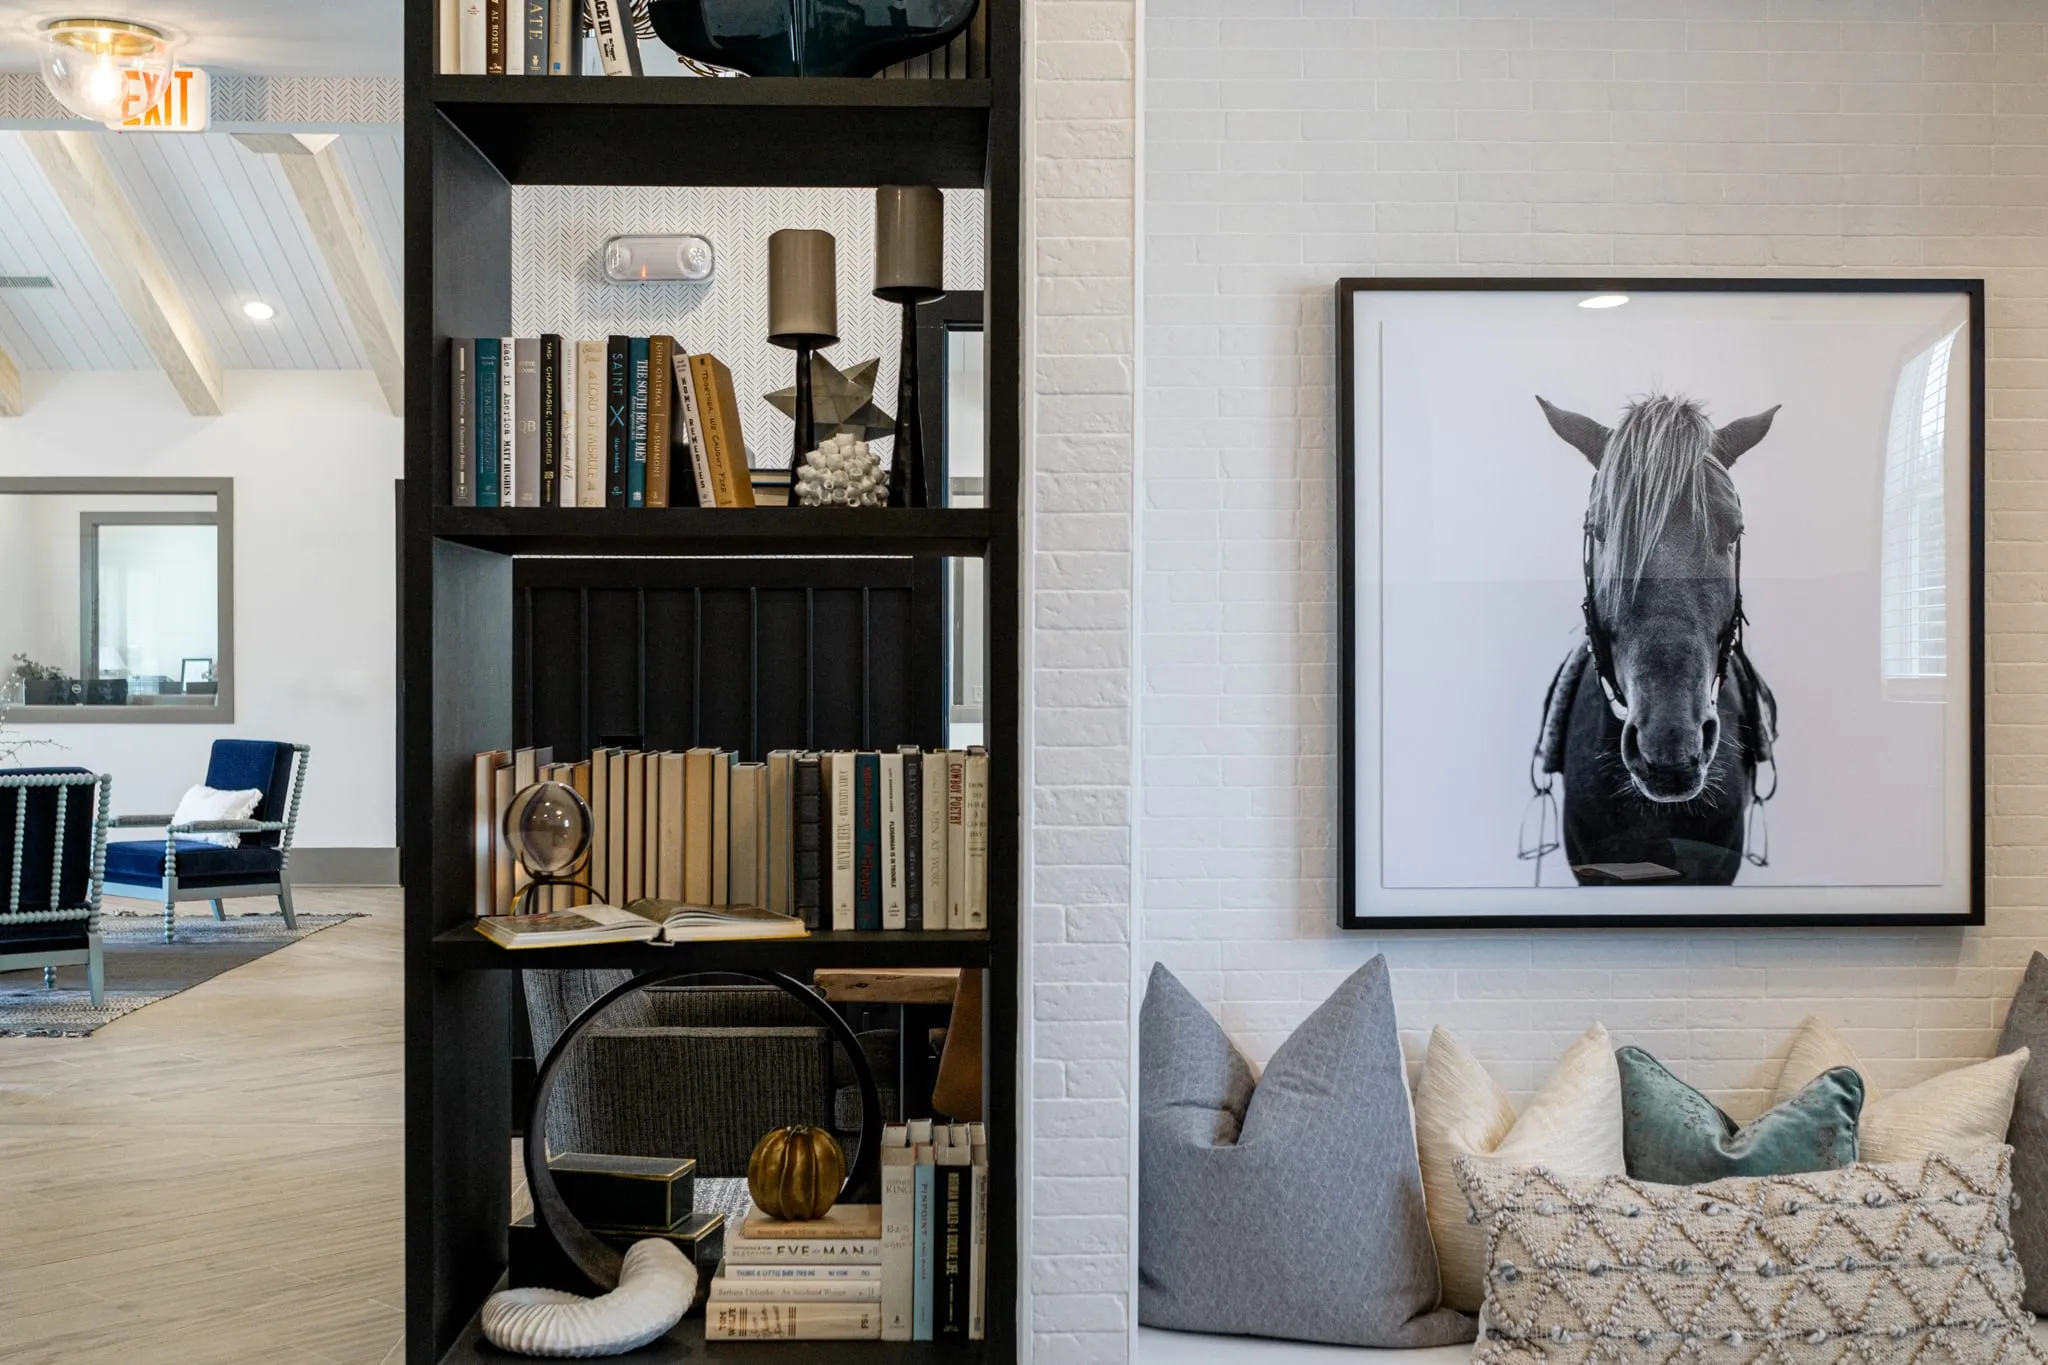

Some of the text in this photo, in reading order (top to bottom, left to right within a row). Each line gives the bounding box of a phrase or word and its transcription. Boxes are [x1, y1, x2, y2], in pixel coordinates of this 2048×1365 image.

[491, 10, 499, 22] AL
[594, 0, 610, 19] CE
[491, 25, 499, 54] ROKER
[598, 20, 612, 35] III
[121, 70, 193, 126] EXIT
[503, 344, 512, 368] Made
[655, 342, 663, 365] JOHN
[503, 375, 512, 387] in
[545, 366, 553, 418] CHAMPAGNE,
[609, 353, 625, 428] SAINT X
[503, 393, 512, 435] America
[634, 360, 648, 464] THE SOUTH BEACH DIET
[588, 382, 600, 479] LORD OF MISRULE
[681, 377, 692, 413] HOME
[688, 419, 706, 489] REMEDIES
[503, 440, 512, 461] MATT
[652, 435, 661, 478] SUMMONS
[503, 464, 512, 496] HUGHES
[950, 763, 963, 826] COWBOY POETRY
[837, 823, 851, 841] NEED
[931, 811, 940, 834] MEN
[931, 837, 940, 854] AT
[837, 852, 851, 872] KNOW
[930, 857, 940, 888] WORK
[886, 1186, 913, 1194] KING
[776, 1246, 809, 1257] EVE
[823, 1246, 864, 1256] MAN
